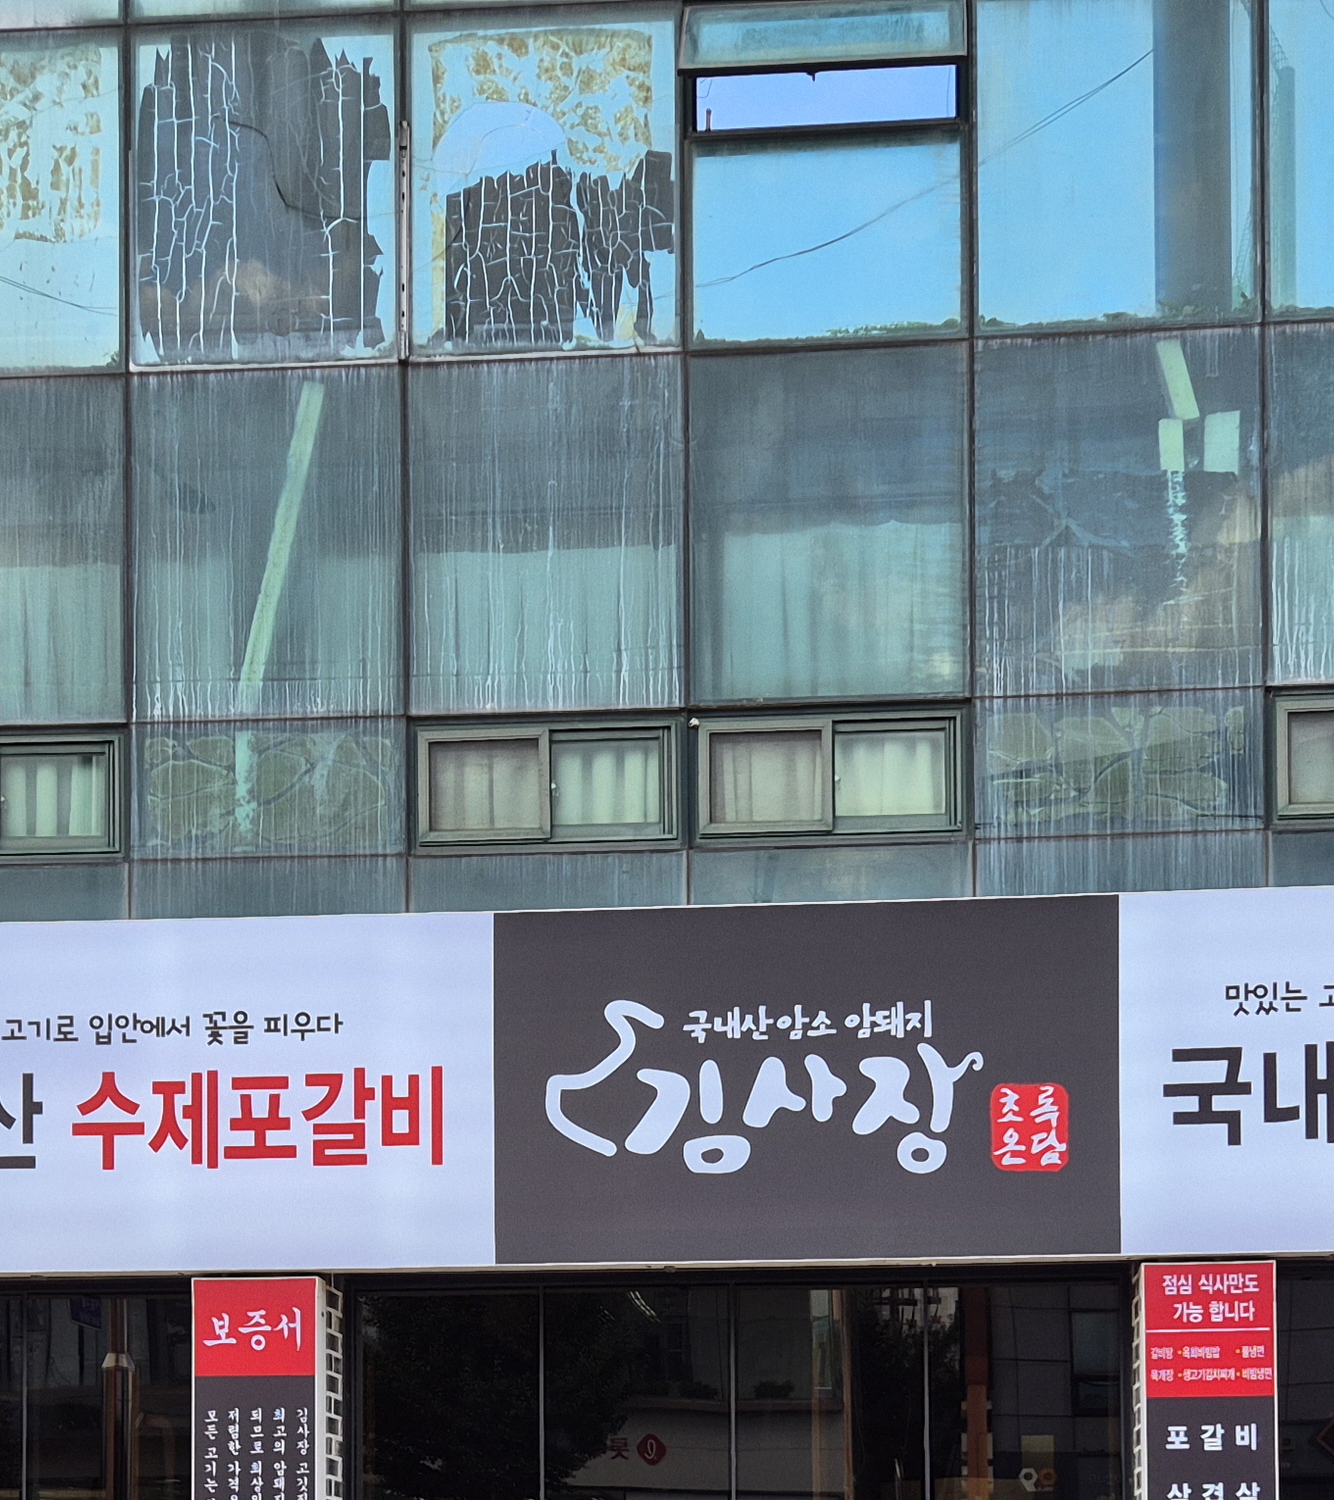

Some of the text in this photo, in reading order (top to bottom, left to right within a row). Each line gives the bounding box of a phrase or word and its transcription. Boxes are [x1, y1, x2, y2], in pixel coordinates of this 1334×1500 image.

[1226, 982, 1307, 1016] 맛있는
[1, 1015, 79, 1044] 고기로
[88, 1012, 191, 1045] 입안에서
[203, 1010, 254, 1046] 꽃을
[263, 1012, 344, 1043] 피우다
[844, 1000, 932, 1039] 암돼지
[71, 1065, 444, 1171] 수제포갈비
[617, 1040, 984, 1174] 김사장
[1162, 1273, 1259, 1295] 점심 식사만도
[202, 1307, 301, 1351] 보증서
[1173, 1300, 1255, 1323] 가능 합니다
[296, 1407, 310, 1456] 김사장
